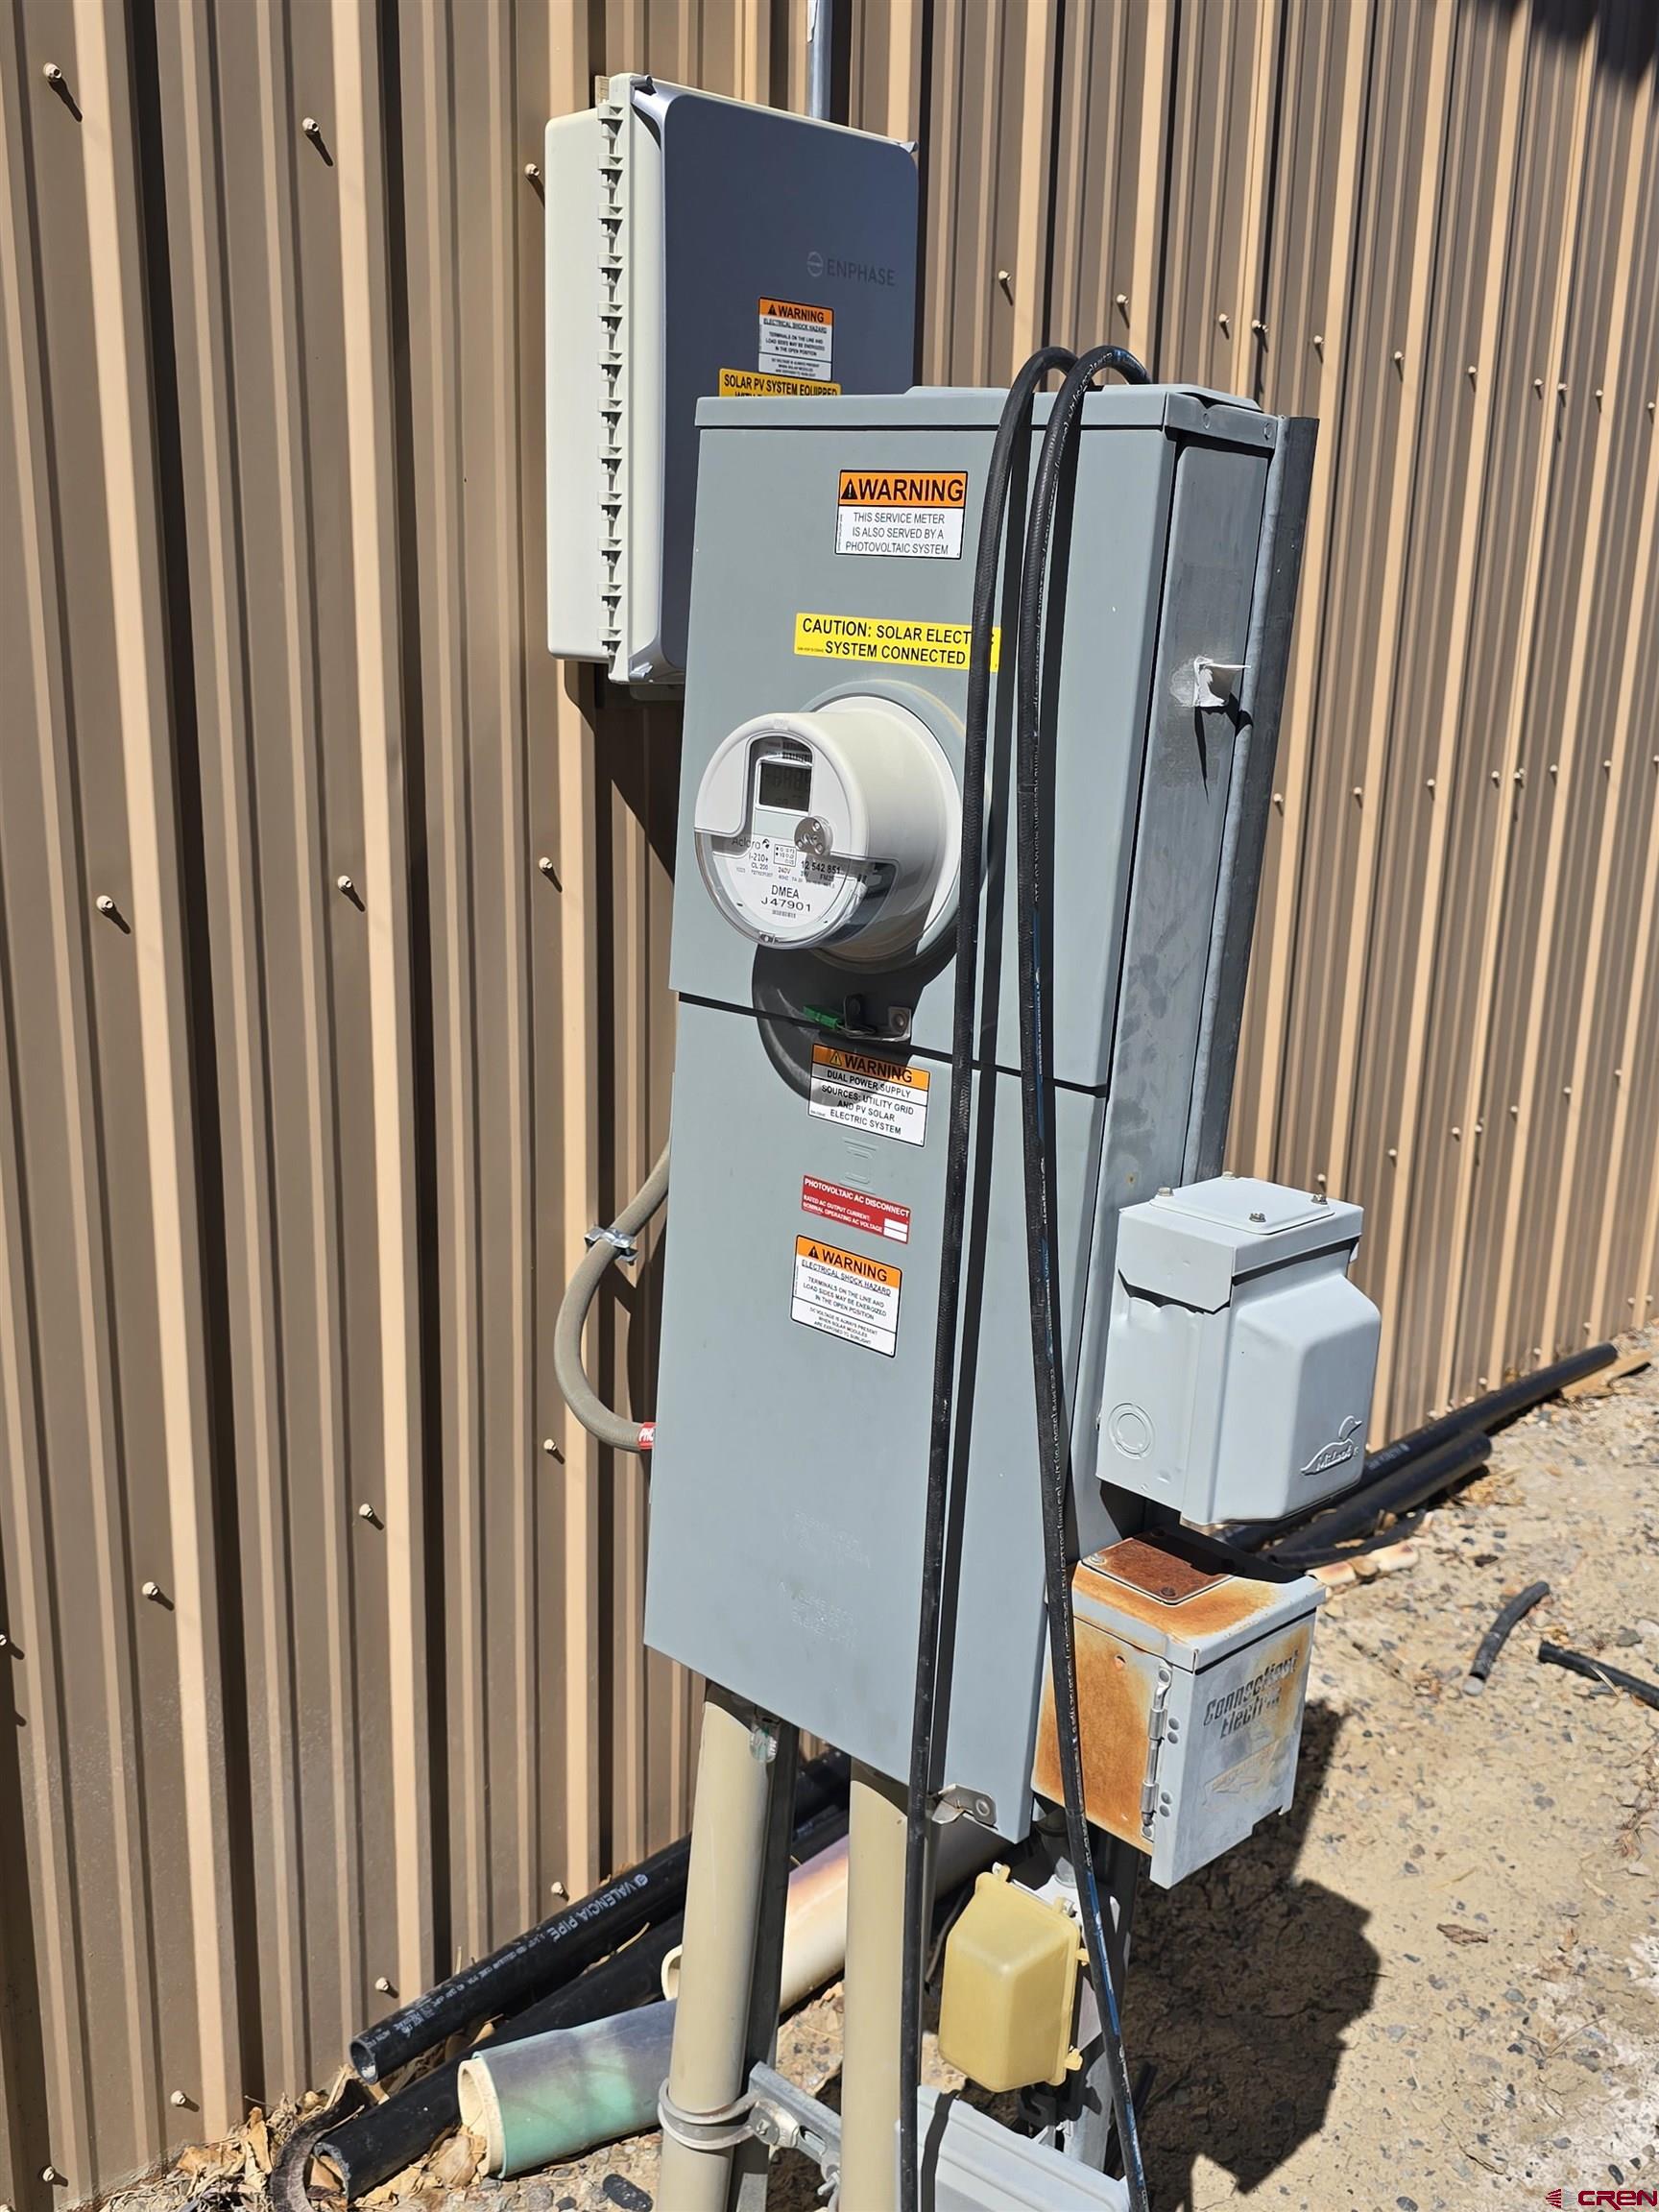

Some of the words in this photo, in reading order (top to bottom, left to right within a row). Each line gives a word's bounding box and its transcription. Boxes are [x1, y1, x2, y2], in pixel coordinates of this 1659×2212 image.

[827, 258, 895, 286] ENPHASE
[778, 305, 824, 323] WARNING
[724, 374, 752, 390] SOLAR
[754, 378, 765, 391] PV
[766, 380, 797, 396] SYSTEM
[857, 478, 964, 502] WARNING
[854, 512, 872, 522] THIS
[874, 513, 912, 524] SERVICE
[914, 514, 945, 524] METER
[852, 527, 861, 537] IS
[862, 527, 885, 538] ALSO
[887, 528, 922, 539] SERVED
[924, 529, 937, 539] BY
[938, 529, 944, 539] A
[845, 541, 911, 553] PHOTOVOLTAIC
[912, 543, 949, 554] SYSTEM
[803, 618, 871, 637] CAUTION:
[876, 625, 923, 641] SOLAR
[825, 640, 878, 657] SYSTEM
[881, 645, 966, 665] CONNECTED
[801, 861, 810, 870] 12
[812, 863, 825, 873] 542
[828, 865, 841, 874] 851
[761, 897, 811, 912] J47901
[771, 885, 799, 899] DMEA
[845, 1055, 912, 1082] WARNING
[827, 1070, 848, 1082] DUAL
[850, 1075, 878, 1090] POWER
[879, 1083, 911, 1098] SUPPLY
[821, 1084, 861, 1101] SOURCES:
[863, 1095, 892, 1109] UTILITY
[894, 1104, 914, 1115] GRID
[837, 1100, 854, 1110] AND
[856, 1105, 866, 1114] PV
[868, 1108, 895, 1121] SOLAR
[830, 1109, 868, 1125] ELECTRIC
[869, 1120, 901, 1135] SYSTEM
[805, 1178, 854, 1200] PHOTOVOLTAIC
[854, 1194, 865, 1203] AC
[865, 1198, 910, 1217] DISCONNECT
[802, 1259, 839, 1277] ELECTRICAL
[841, 1273, 863, 1286] SHOCK
[865, 1281, 891, 1296] HAZARD
[822, 1249, 887, 1282] WARNING
[803, 1283, 818, 1292] LOAD
[819, 1288, 834, 1298] SIDES
[835, 1293, 846, 1302] MAY
[856, 1300, 887, 1316] ENERGIZED
[808, 1276, 837, 1291] TERMINALS
[848, 1290, 858, 1298] THE
[859, 1294, 871, 1304] LINE
[873, 1299, 884, 1308] AND
[833, 1300, 848, 1310] OPEN
[849, 1305, 874, 1320] POSITION
[581, 1880, 638, 1921] VALENCIA
[547, 1917, 578, 1943] PIPE
